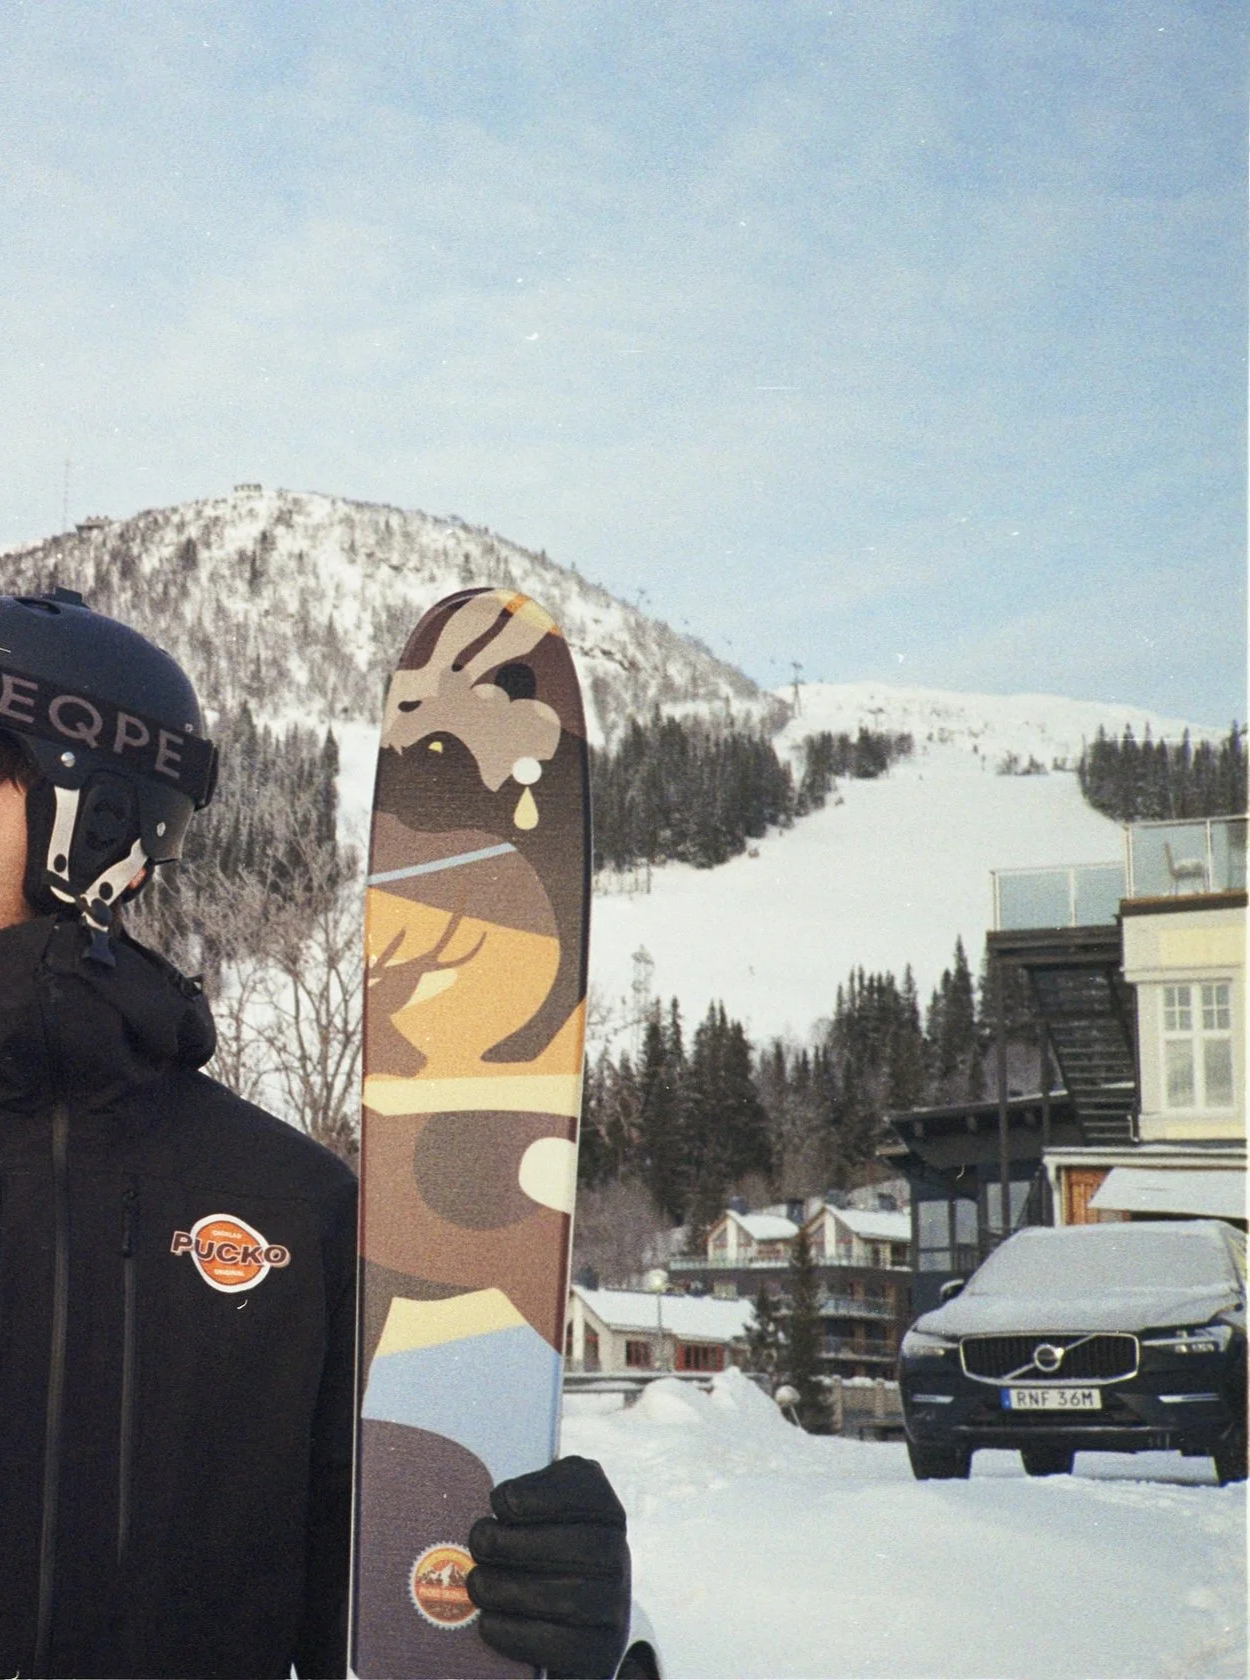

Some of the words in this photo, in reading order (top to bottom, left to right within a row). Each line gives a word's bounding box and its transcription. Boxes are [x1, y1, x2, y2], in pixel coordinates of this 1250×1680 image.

[170, 1231, 291, 1268] PUCKO
[1017, 1391, 1049, 1407] RNF
[1058, 1391, 1094, 1407] 36M
